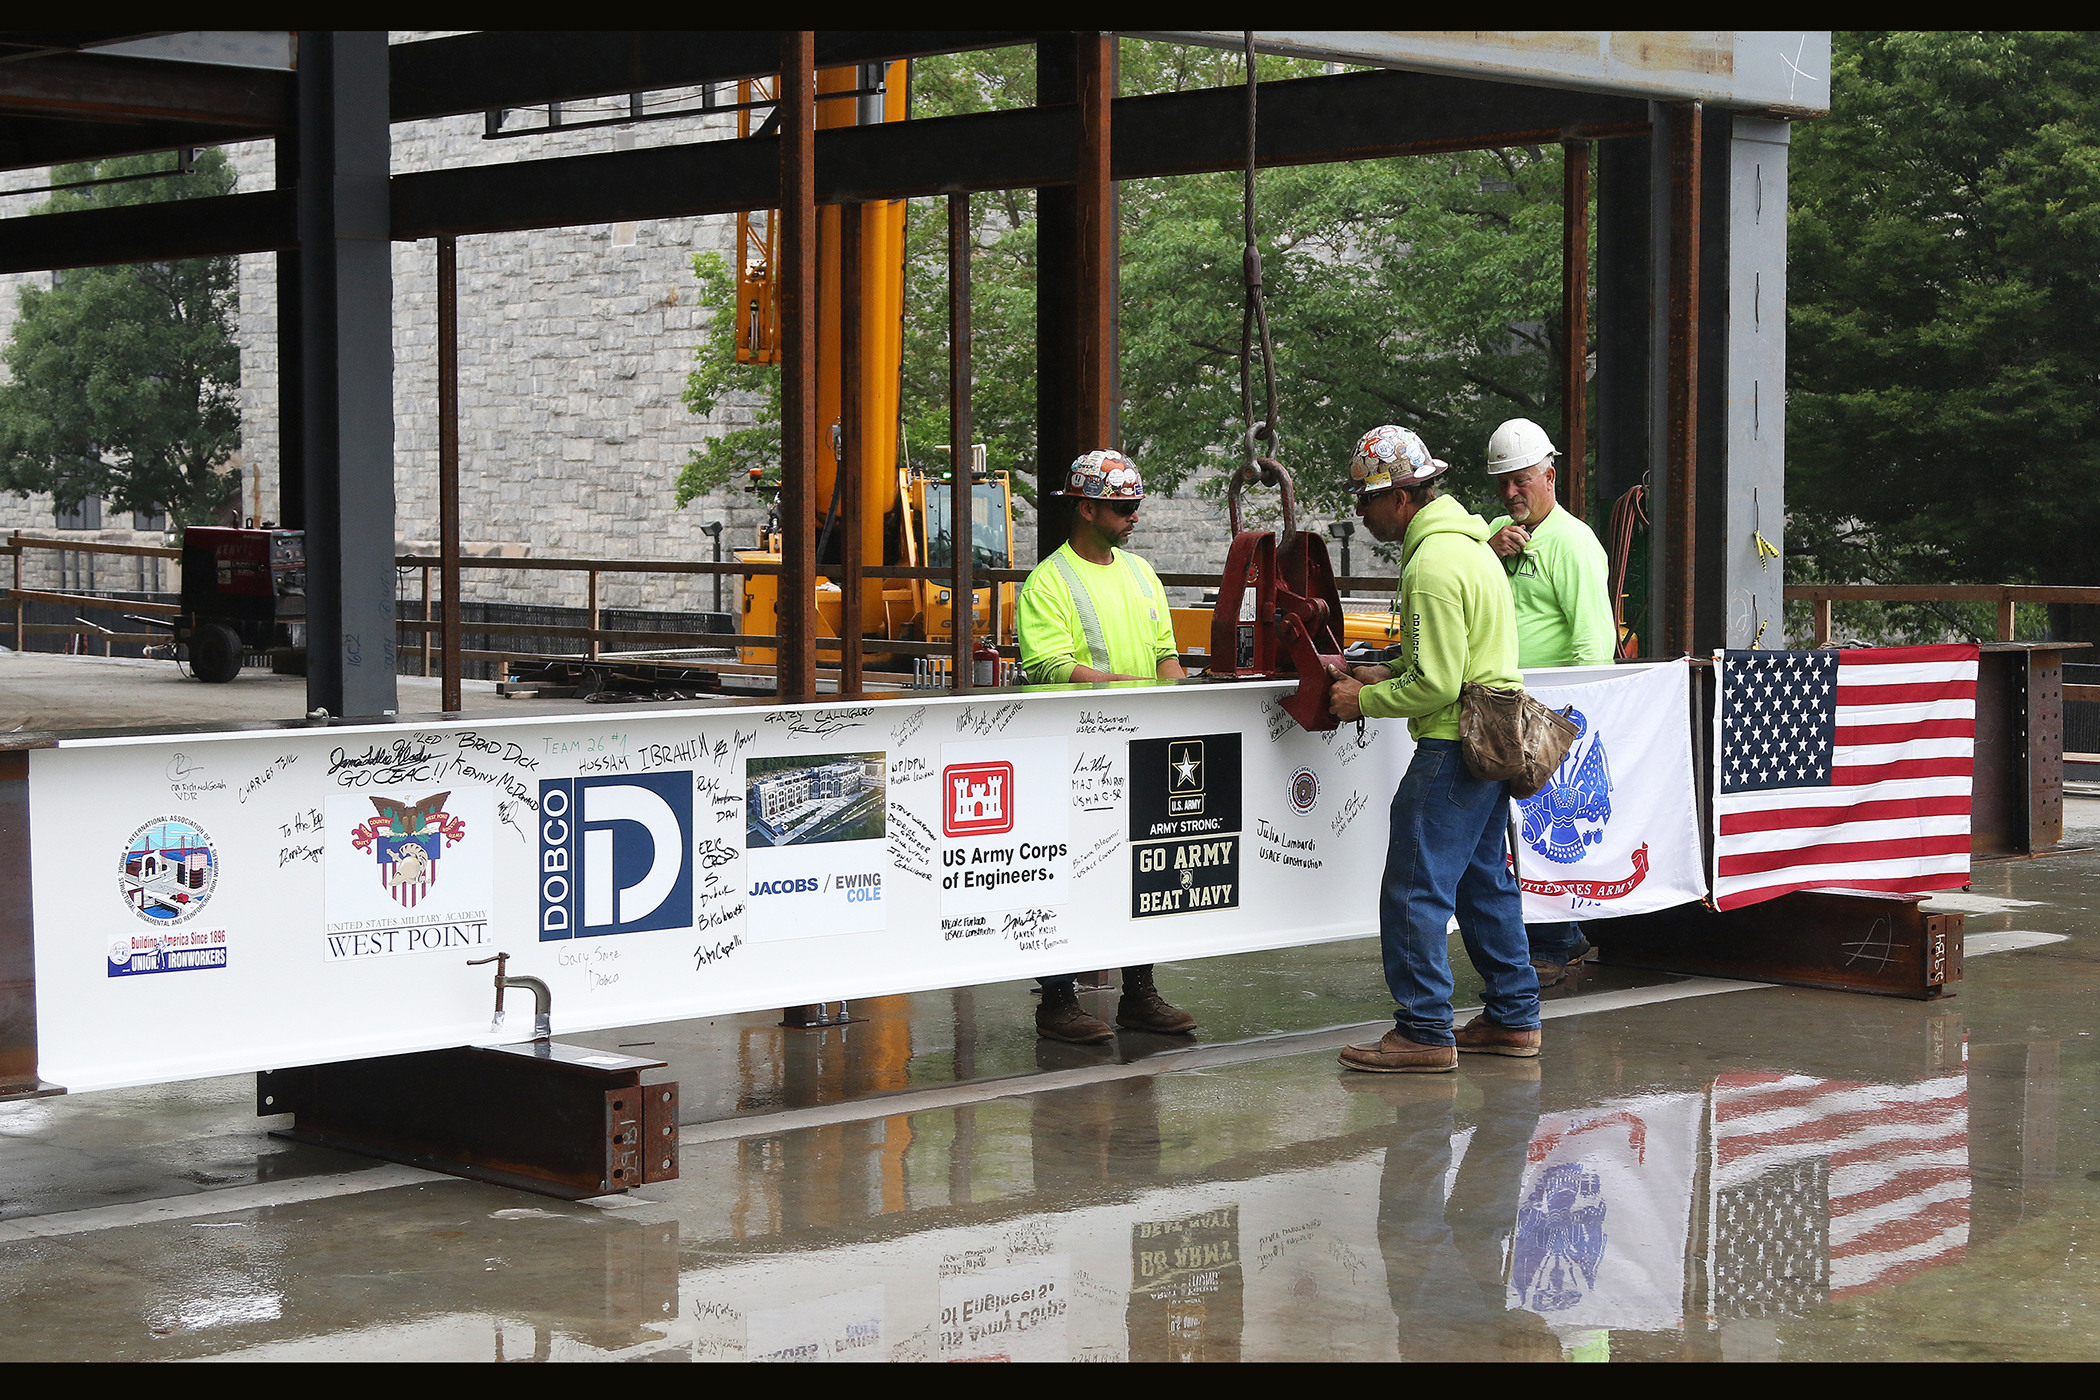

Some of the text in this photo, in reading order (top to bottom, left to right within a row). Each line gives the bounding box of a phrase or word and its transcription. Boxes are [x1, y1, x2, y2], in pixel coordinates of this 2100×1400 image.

[455, 731, 502, 754] BRAD
[542, 737, 581, 755] TEAM
[587, 736, 605, 752] 26
[579, 754, 630, 776] HOSSAM
[638, 731, 710, 772] IBRAHIM
[337, 769, 372, 787] GO
[449, 750, 497, 783] KENNY
[238, 766, 274, 804] CHARLES
[1171, 798, 1202, 811] U.S. ARMY
[128, 815, 211, 845] INTERNATIONAL ASSOCIATION OF
[278, 824, 291, 838] To
[294, 811, 311, 834] the
[1150, 822, 1177, 836] ARMY
[1257, 818, 1280, 844] Julia
[211, 848, 220, 879] WORKERS
[543, 789, 569, 932] DOBCO
[943, 842, 1068, 867] US Army Corps
[1139, 841, 1233, 874] GO ARMY
[1259, 846, 1281, 863] USACE
[209, 881, 218, 893] IRON
[749, 877, 819, 896] JACOBS
[835, 872, 882, 890] EWING
[943, 873, 960, 890] of
[1597, 879, 1635, 896] ARMY
[847, 886, 882, 903] COLE
[1139, 884, 1233, 914] BEAT NAVY
[136, 911, 170, 927] ORNAMENTAL
[183, 893, 212, 922] REINFORCING
[327, 909, 488, 932] UNITED STATES MILITARY ACADEMY
[131, 936, 158, 950] Building
[190, 931, 209, 946] Since
[210, 929, 226, 943] 1896
[327, 922, 488, 958] WEST POINT
[167, 949, 226, 969] IRONWORKERS
